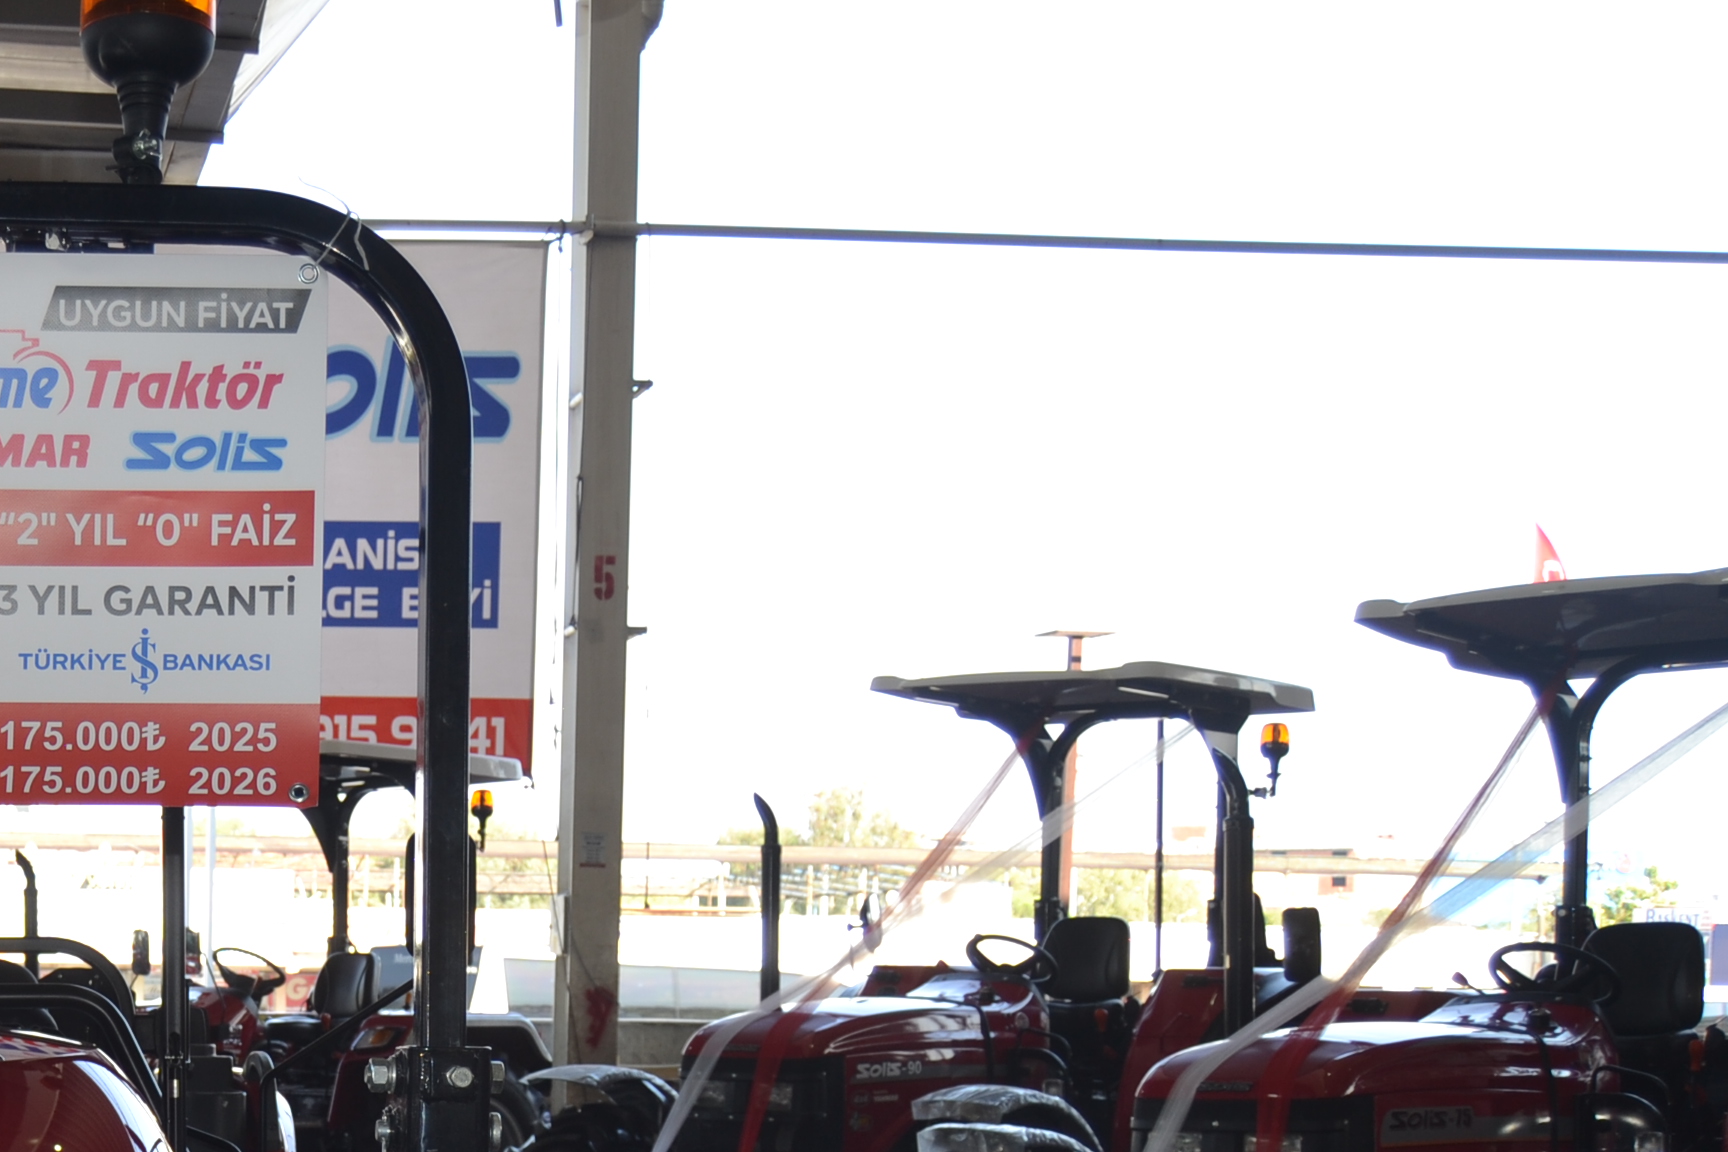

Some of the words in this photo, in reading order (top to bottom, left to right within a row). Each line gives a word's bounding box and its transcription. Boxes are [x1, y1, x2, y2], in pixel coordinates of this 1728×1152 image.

[58, 299, 186, 328] UYGUN
[198, 292, 294, 330] FİYAT
[85, 359, 284, 410] Traktör
[326, 338, 522, 444] ols
[66, 513, 126, 547] YIL
[210, 503, 297, 547] FAİZ
[324, 530, 420, 570] ANİS
[28, 585, 92, 616] YIL
[103, 575, 296, 616] GARANTİ
[593, 554, 616, 600] 5
[18, 648, 126, 672] TÜRKİYE
[163, 653, 271, 672] BANKASI
[188, 722, 278, 752] 2025
[322, 714, 386, 743] 15
[188, 766, 278, 796] 2026
